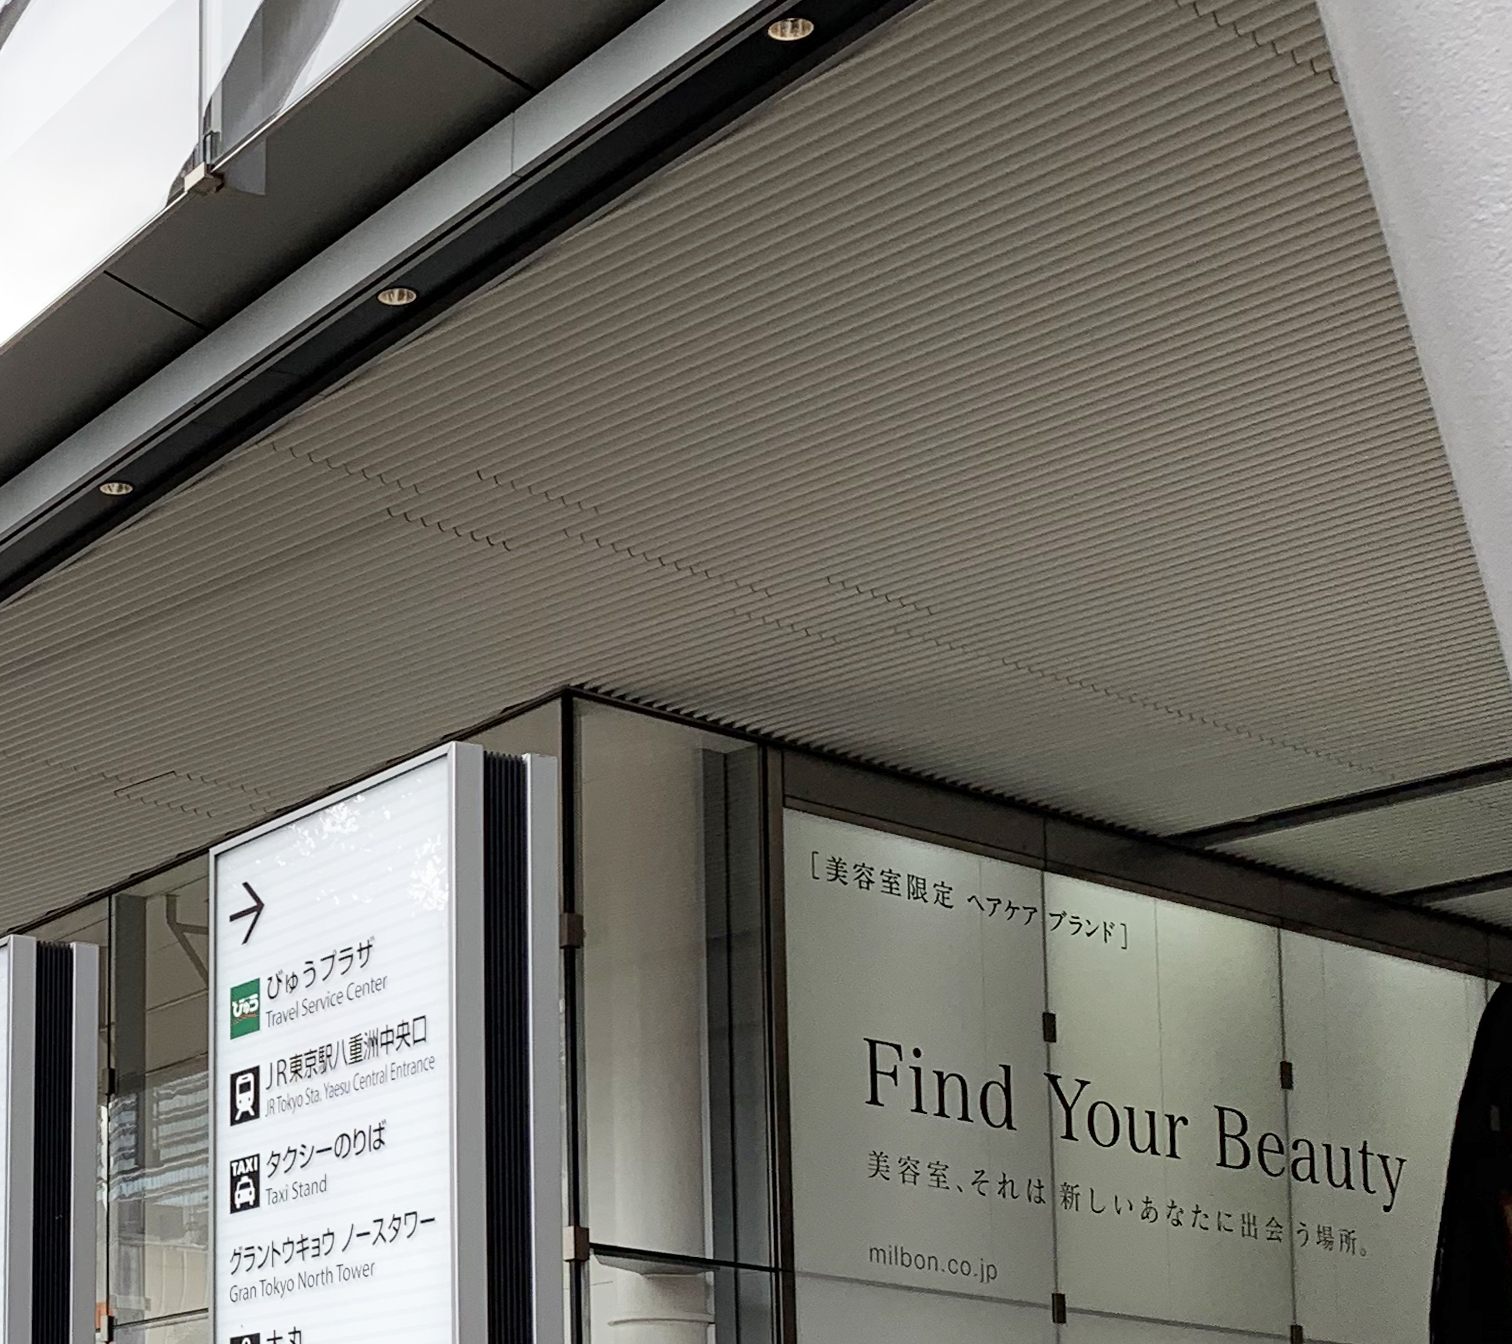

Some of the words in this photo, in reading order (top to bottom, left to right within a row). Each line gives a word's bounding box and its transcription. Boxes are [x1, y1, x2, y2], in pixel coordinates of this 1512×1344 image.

[267, 936, 375, 1000] びゅうプラザ
[266, 1001, 299, 1027] Travel
[301, 991, 343, 1017] Service
[346, 976, 388, 1001] Center
[266, 1015, 427, 1090] JR東京駅八重洲中央口
[265, 1099, 275, 1117] JR
[276, 1088, 303, 1113] Tokyo
[305, 1084, 322, 1105] Sta.
[324, 1080, 350, 1101] Yaesu
[353, 1065, 388, 1090] Central
[390, 1054, 436, 1080] Entrance
[267, 1120, 386, 1178] タクシーのりば
[863, 1037, 1017, 1132] Find
[1043, 1070, 1188, 1161] Your
[1213, 1105, 1407, 1213] Beauty
[231, 1156, 259, 1176] TAXI
[266, 1184, 288, 1205] Taxi
[292, 1174, 328, 1200] Stand
[230, 1228, 335, 1275] グラントウキョウ
[342, 1211, 436, 1252] ノースタワー
[869, 1245, 998, 1284] milbon.co.jp
[230, 1283, 256, 1303] Gran
[260, 1272, 294, 1299] Tokyo
[298, 1267, 333, 1290] North
[336, 1261, 375, 1283] Tower
